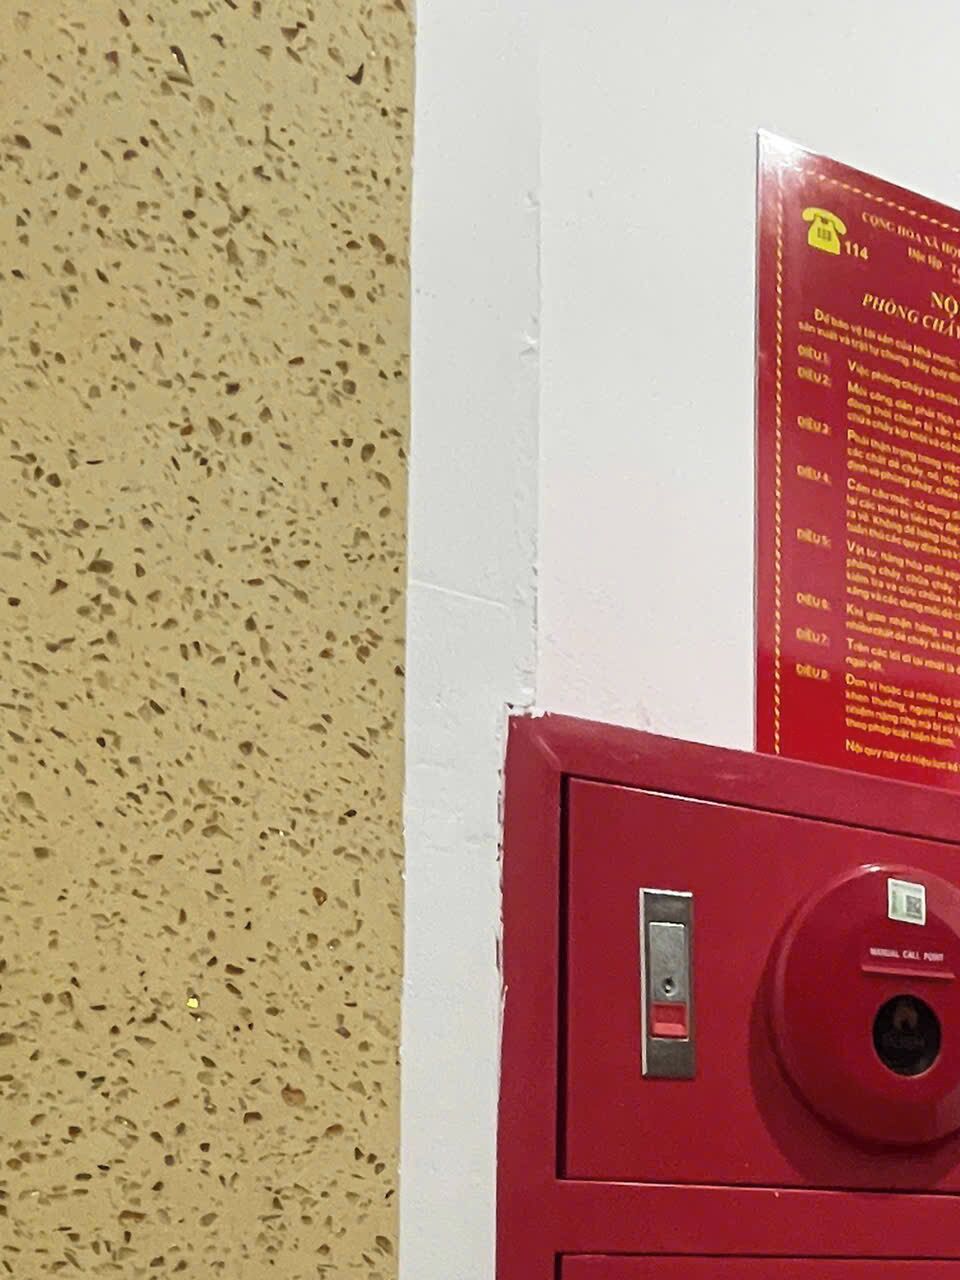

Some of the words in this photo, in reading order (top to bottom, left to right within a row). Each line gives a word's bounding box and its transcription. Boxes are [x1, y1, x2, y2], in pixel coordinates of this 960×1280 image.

[844, 240, 868, 259] 114
[862, 294, 918, 323] PHÒNG
[869, 947, 899, 958] MANUAL
[902, 950, 920, 960] CALL
[923, 952, 944, 962] POINT
